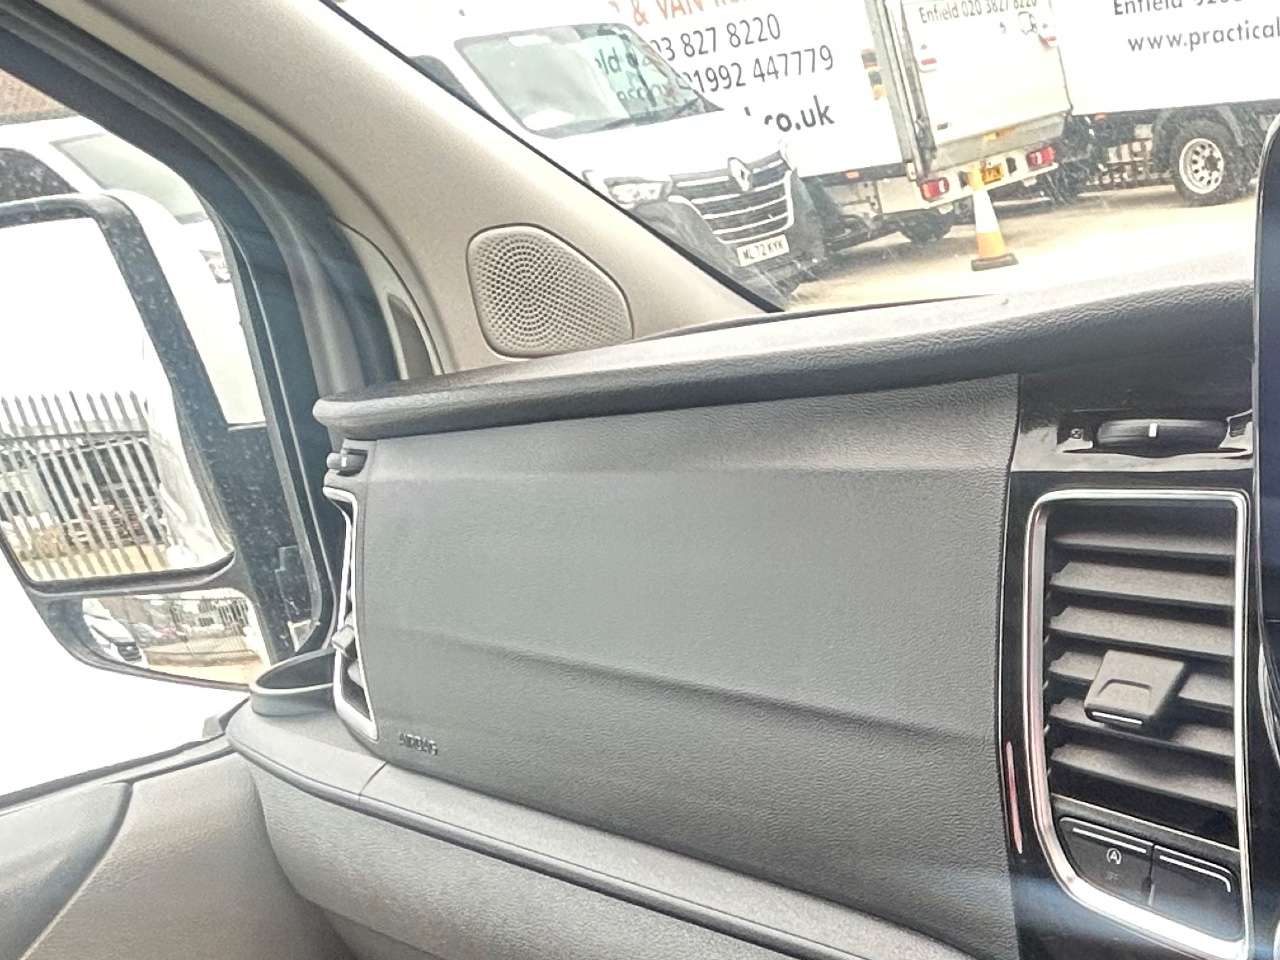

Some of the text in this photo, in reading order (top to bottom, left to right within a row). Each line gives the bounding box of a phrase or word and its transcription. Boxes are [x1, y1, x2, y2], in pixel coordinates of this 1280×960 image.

[680, 27, 717, 58] 827
[725, 13, 781, 48] 8220
[753, 44, 834, 83] 447779
